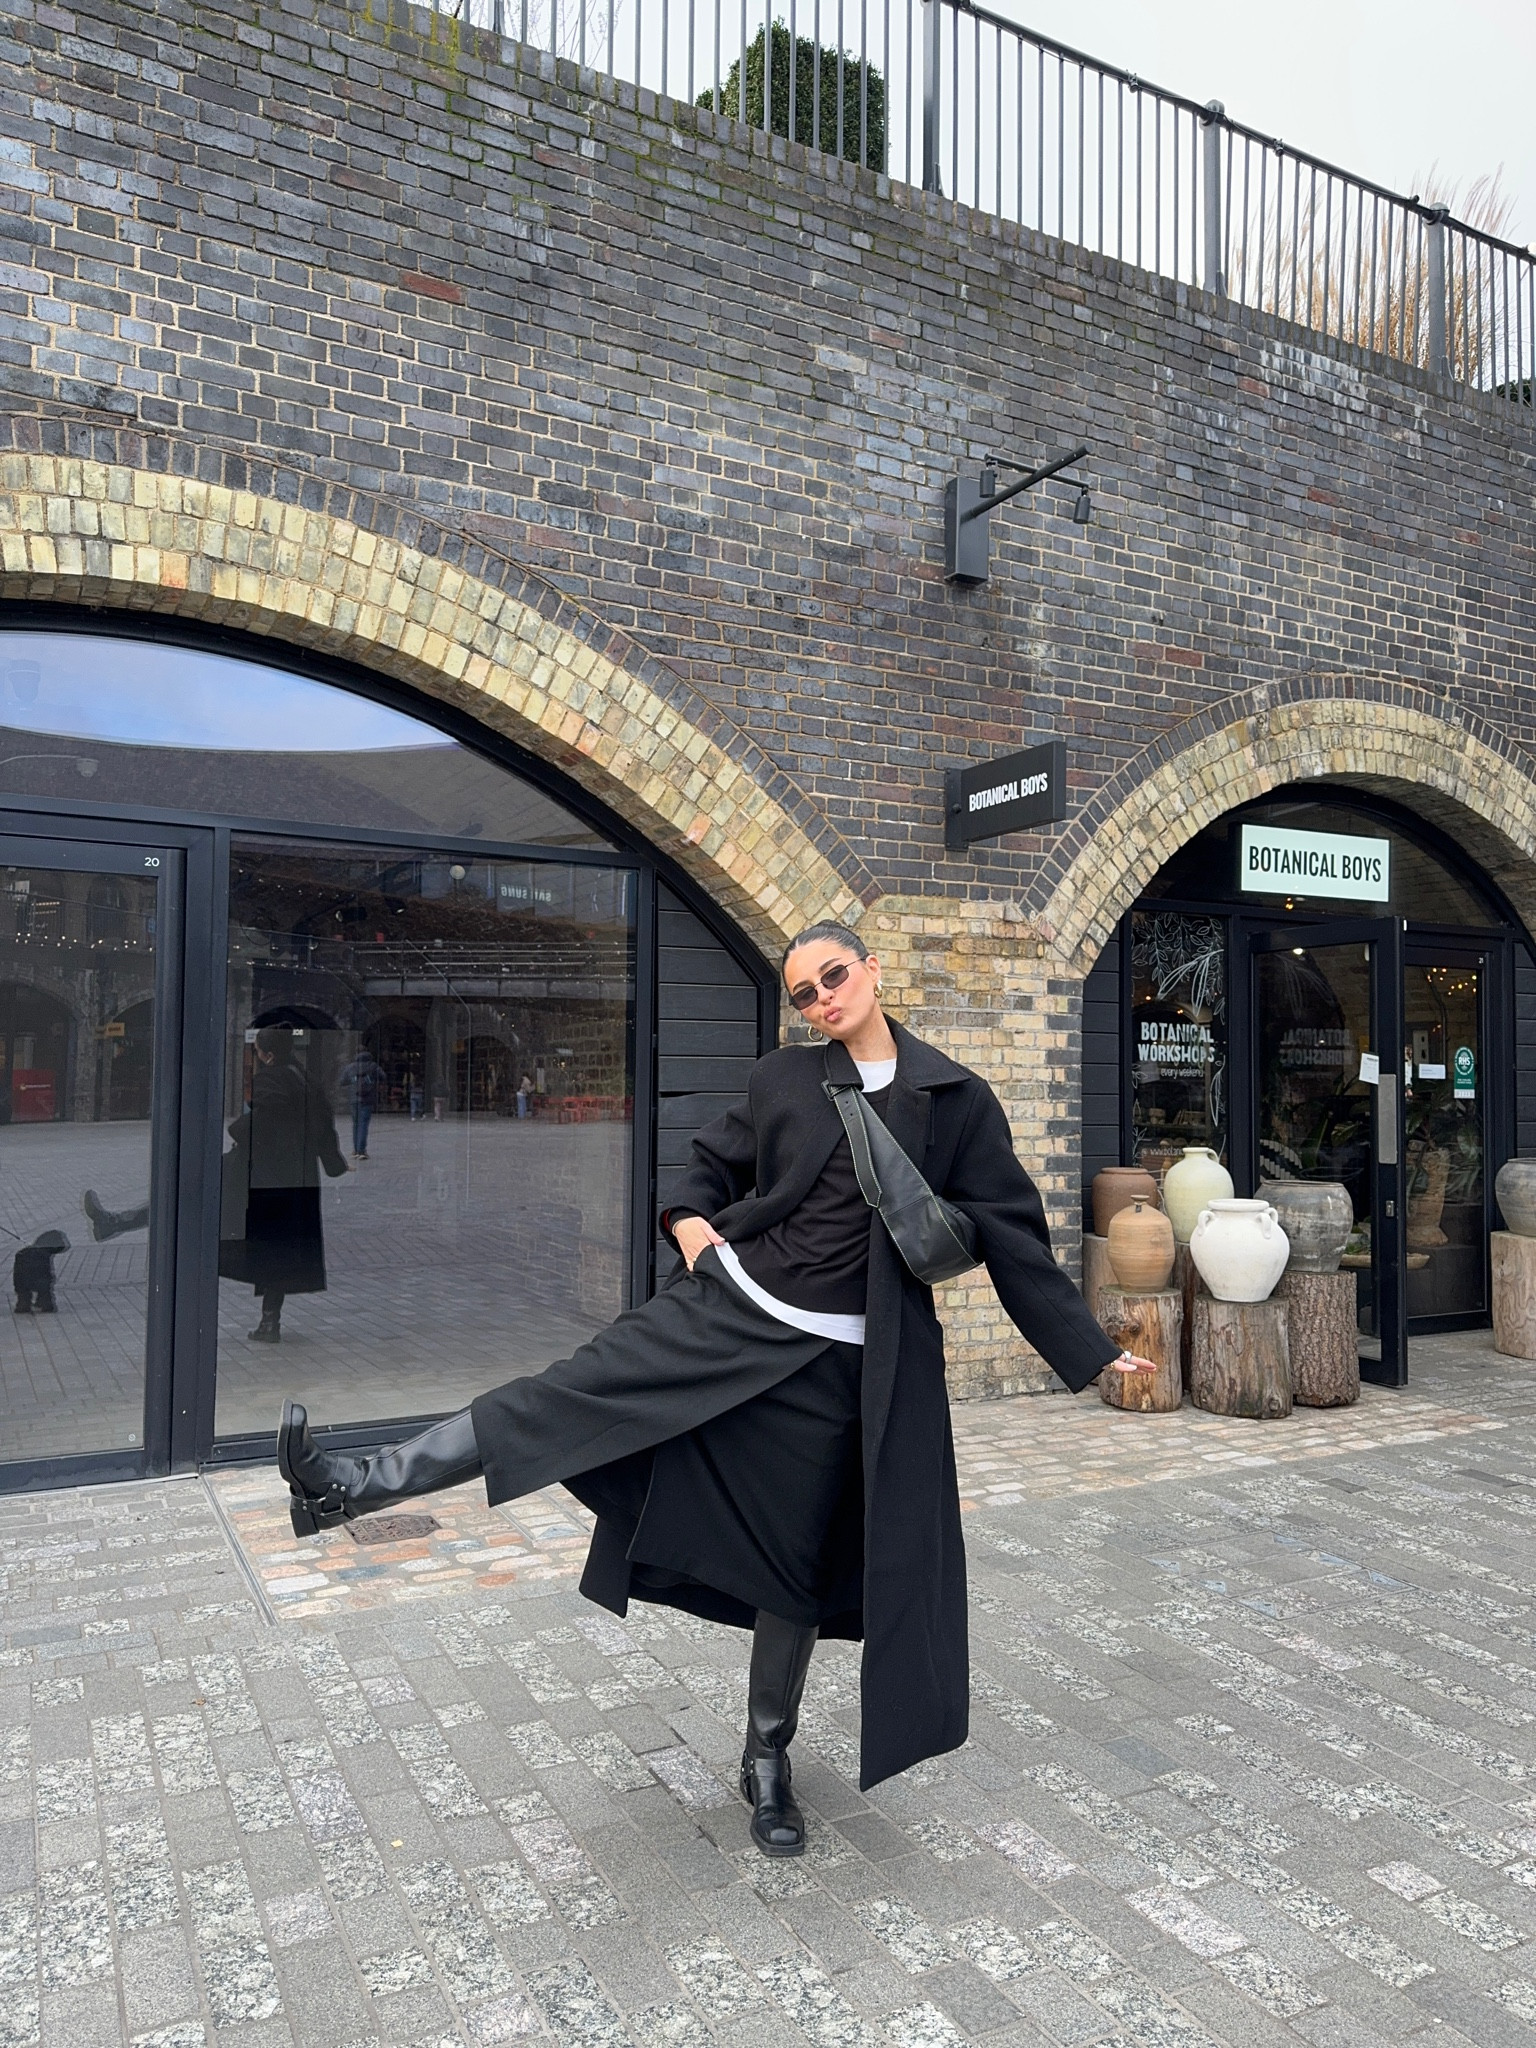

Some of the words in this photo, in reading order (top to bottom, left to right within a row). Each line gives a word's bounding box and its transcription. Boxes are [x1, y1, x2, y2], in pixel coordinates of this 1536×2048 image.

[969, 781, 1020, 812] BOTANICAL
[1020, 772, 1048, 797] BOYS
[144, 856, 160, 867] 20
[1249, 845, 1337, 878] BOTANICAL
[1342, 854, 1382, 882] BOYS
[1141, 1022, 1214, 1043] BOTANICAL
[1137, 1044, 1215, 1063] WORKSHOPS
[1458, 1056, 1471, 1066] RHS
[1161, 1068, 1178, 1080] every
[1179, 1066, 1204, 1078] weekend
